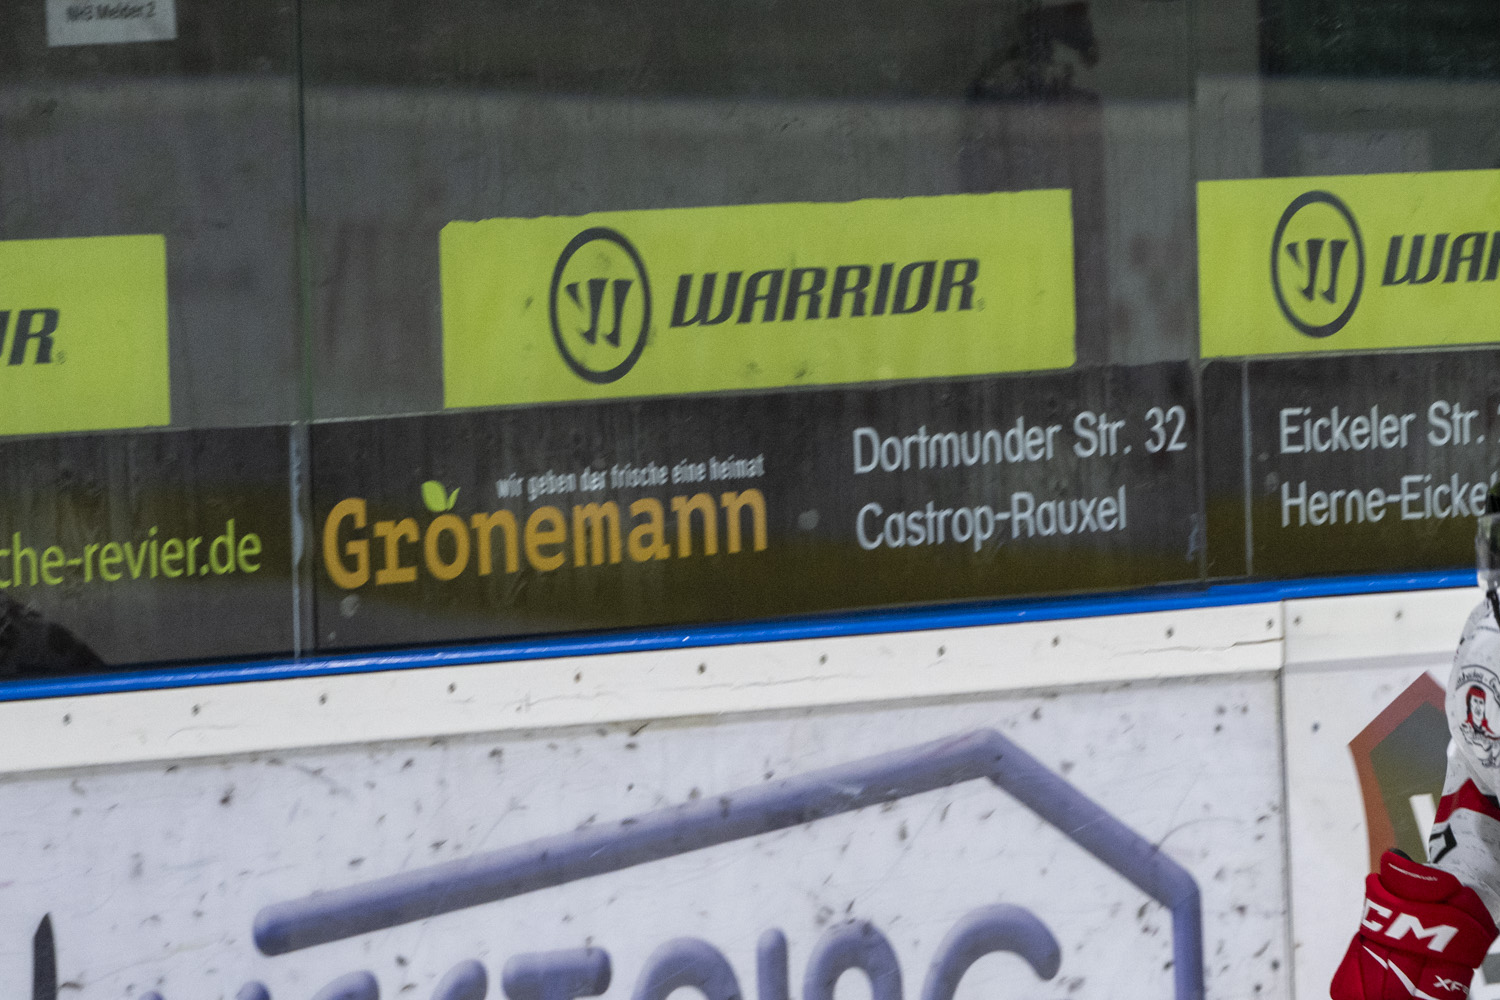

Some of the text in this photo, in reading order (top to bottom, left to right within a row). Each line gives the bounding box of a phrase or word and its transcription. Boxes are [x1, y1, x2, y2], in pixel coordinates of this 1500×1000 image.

[669, 258, 979, 329] WARRIOR
[853, 405, 1187, 475] Dortmunder Str. 32
[1280, 404, 1417, 454] Eickeler
[1427, 400, 1485, 447] Str.
[496, 453, 765, 502] wir geben der frische eine heimat
[856, 484, 1127, 553] Castrop-Rauxel
